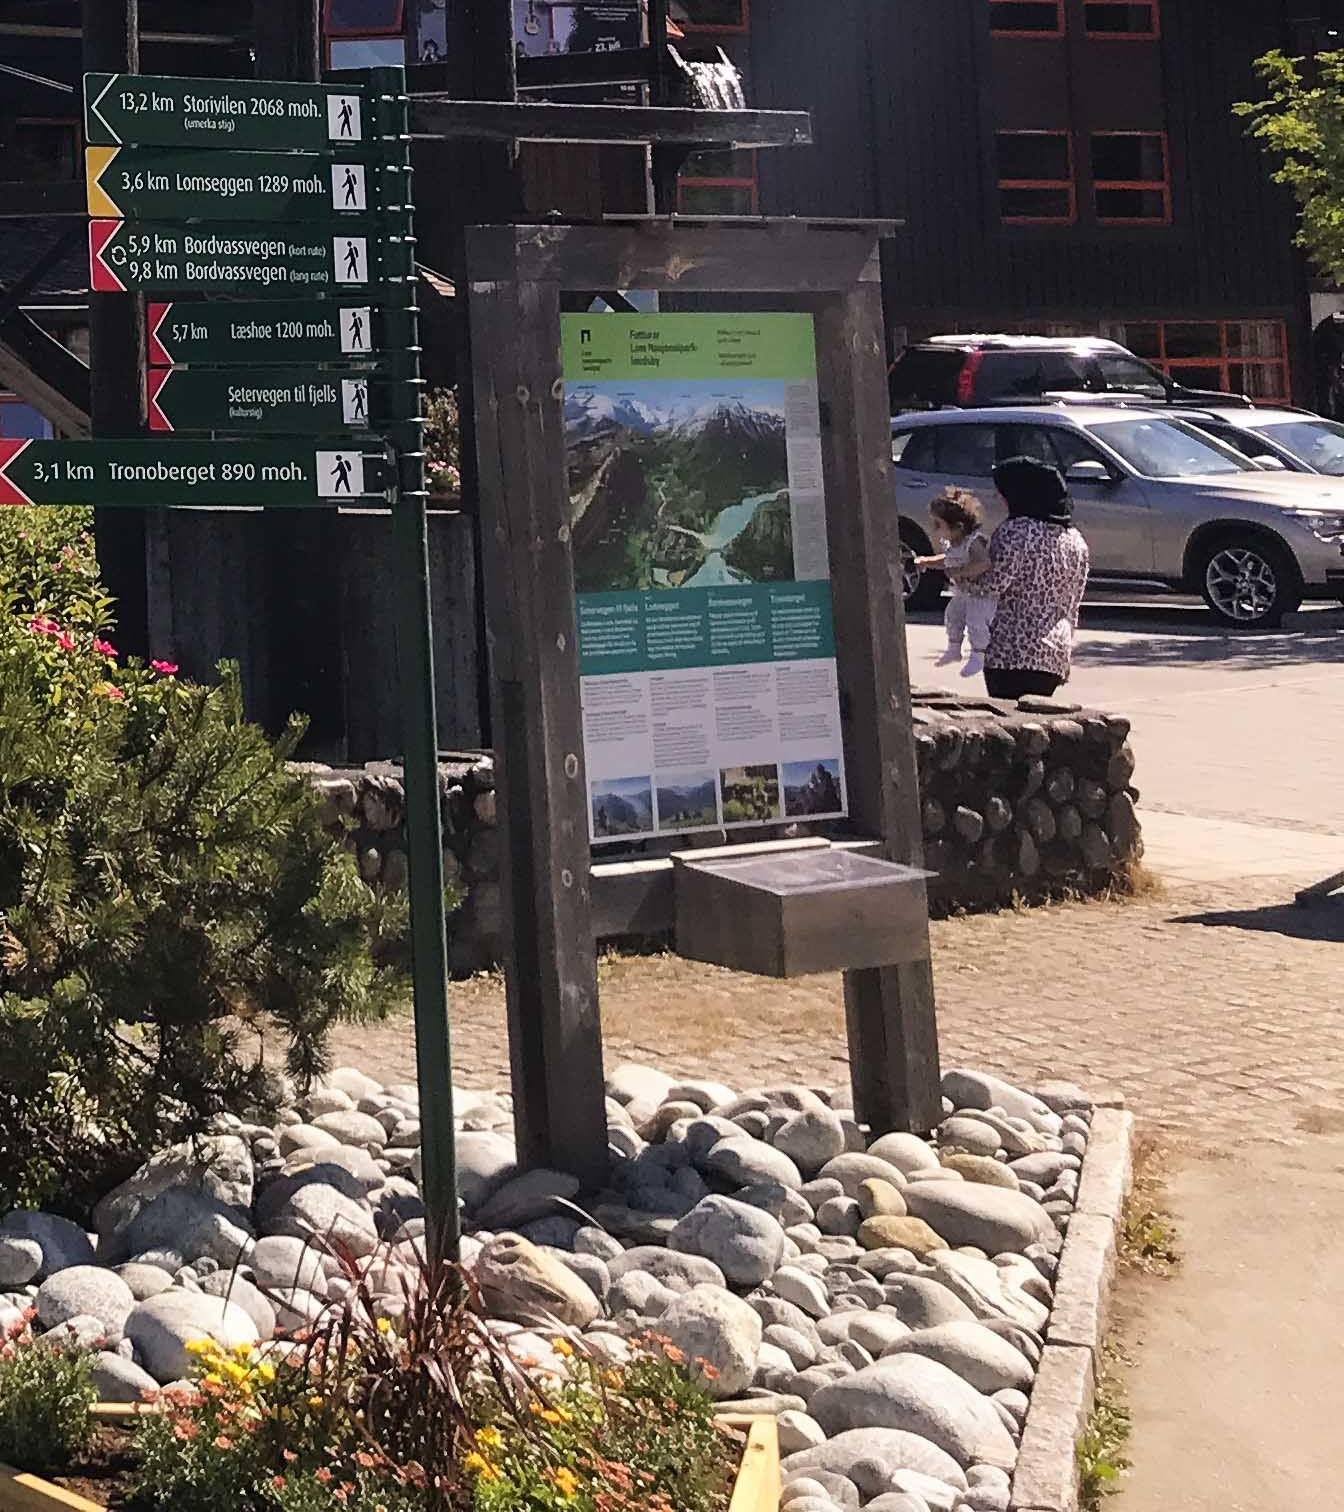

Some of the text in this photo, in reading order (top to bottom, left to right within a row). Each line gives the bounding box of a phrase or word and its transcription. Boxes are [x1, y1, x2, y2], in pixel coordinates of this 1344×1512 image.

[119, 92, 148, 114] 13,2
[151, 91, 174, 112] km
[250, 97, 285, 117] 2068
[288, 98, 322, 118] moh.
[121, 170, 327, 197] 3,6 km Lomseggen 1289 moh.
[128, 235, 151, 256] 5,9
[154, 233, 177, 254] km
[184, 235, 286, 260] Bordvassvegen
[129, 261, 152, 283] 9,8
[155, 259, 178, 280] km
[185, 261, 287, 286] Bordvassvegen
[172, 324, 188, 343] 5,7
[190, 322, 208, 340] km
[275, 321, 303, 339] 1200
[306, 319, 336, 338] moh.
[228, 384, 337, 407] Setervegen til fjells
[33, 460, 307, 485] 3,1 km Tronoberget 890 moh.
